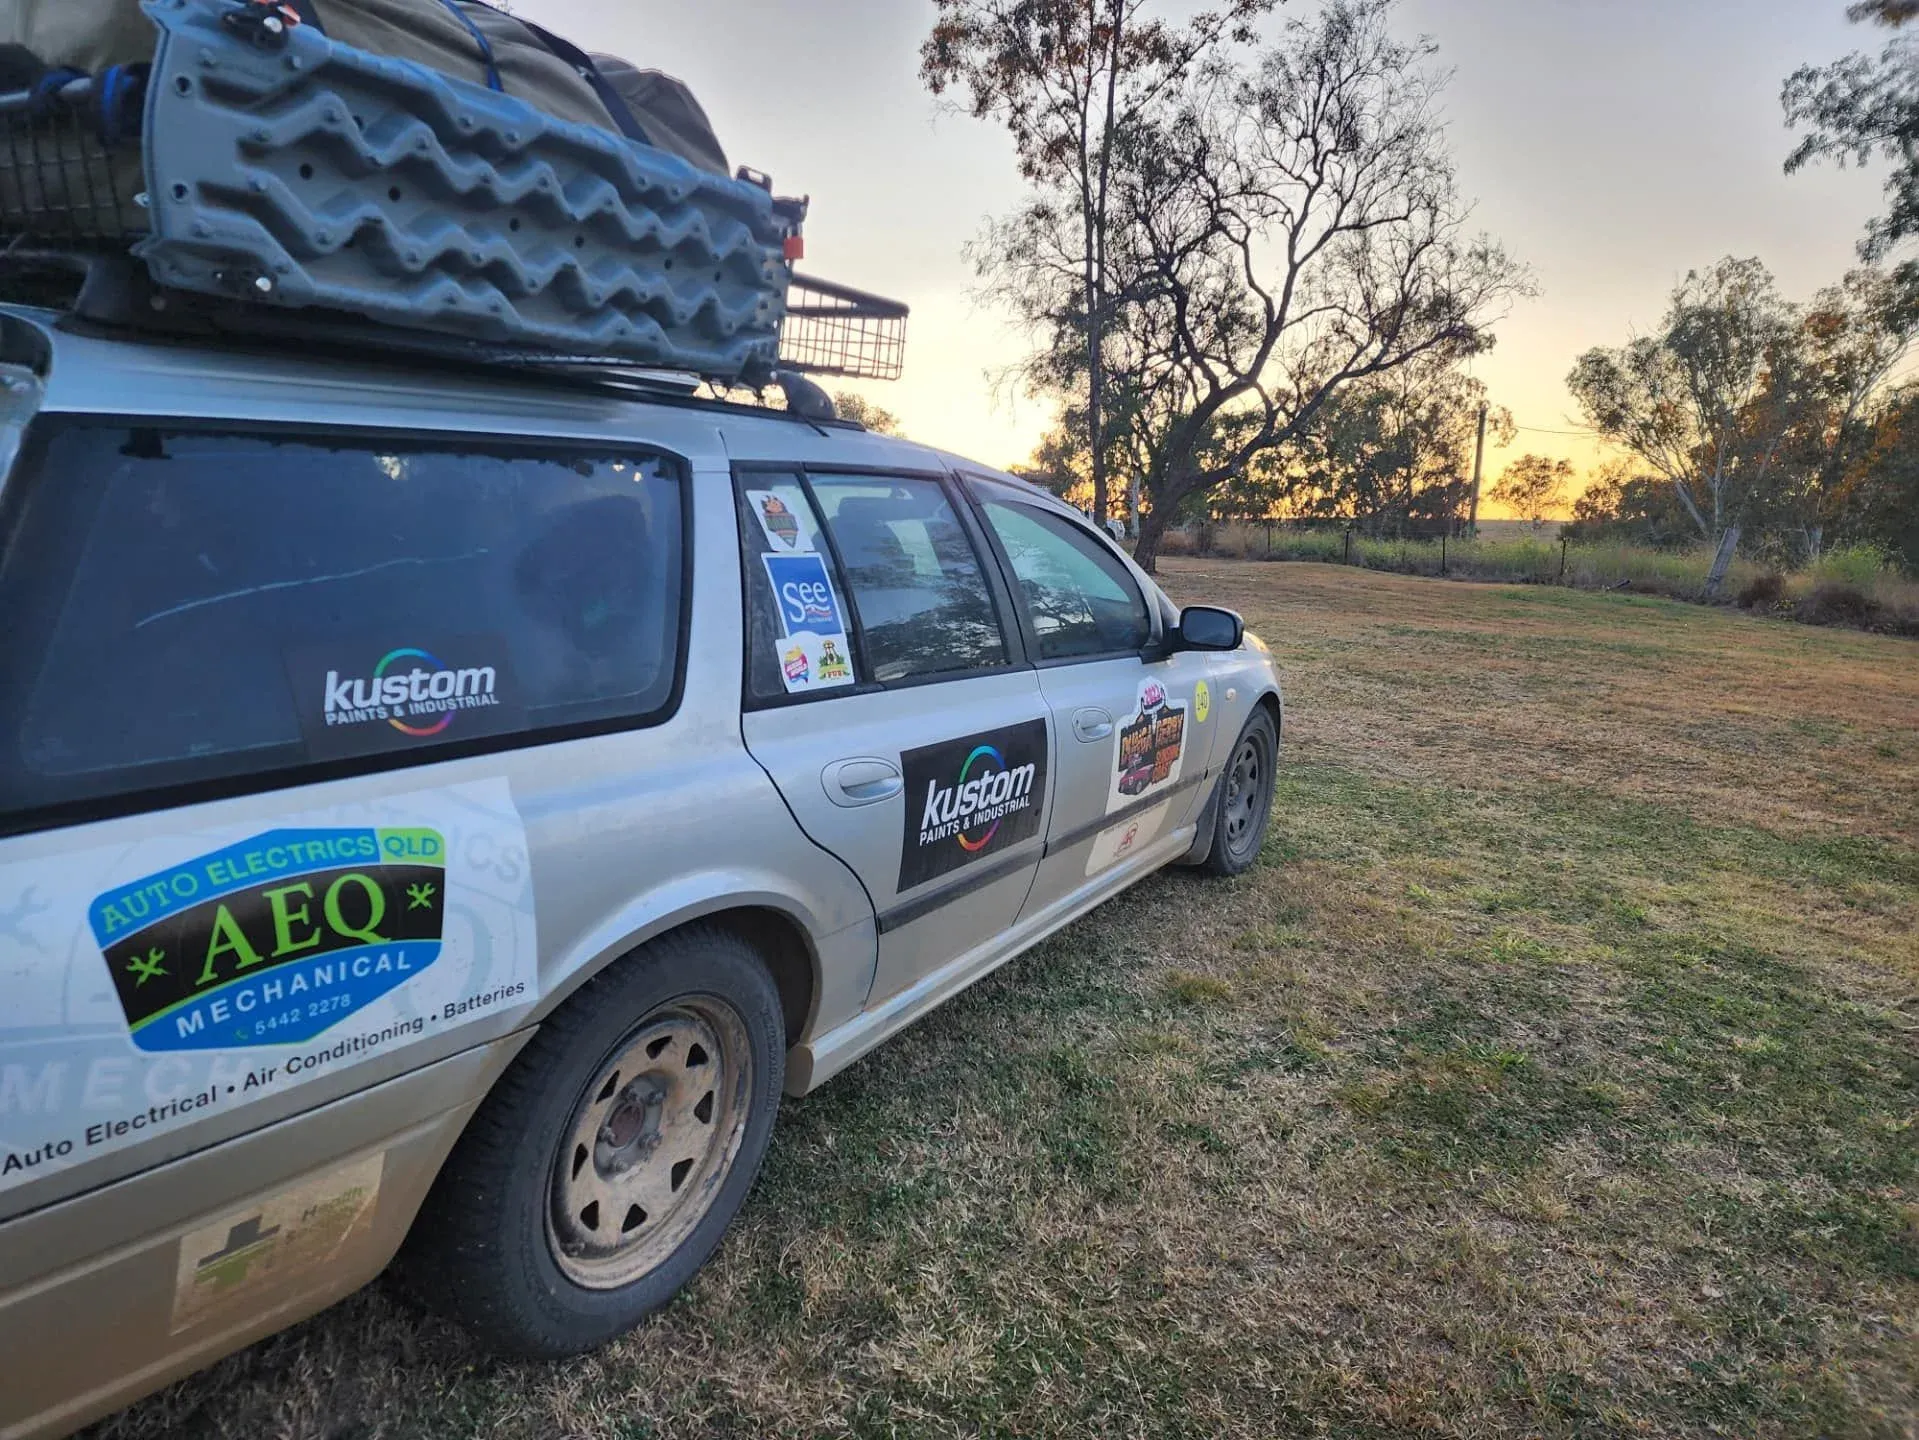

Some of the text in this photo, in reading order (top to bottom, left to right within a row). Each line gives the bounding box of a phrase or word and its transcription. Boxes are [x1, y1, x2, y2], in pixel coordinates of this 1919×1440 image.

[782, 581, 828, 623] See
[324, 666, 496, 713] kustom
[325, 693, 500, 727] PAINTS & INDUSTRIAL
[920, 794, 1031, 847] PAINTS & INDUSTRIAL
[921, 763, 1035, 831] kustom
[101, 836, 440, 934] AUTO ELECTRICS QLD
[195, 872, 392, 986] AEQ
[175, 951, 411, 1039] MECHANICAL
[255, 994, 351, 1036] 5442 2278
[2, 982, 525, 1176] Auto Electrical Air Conditioning Batteries
